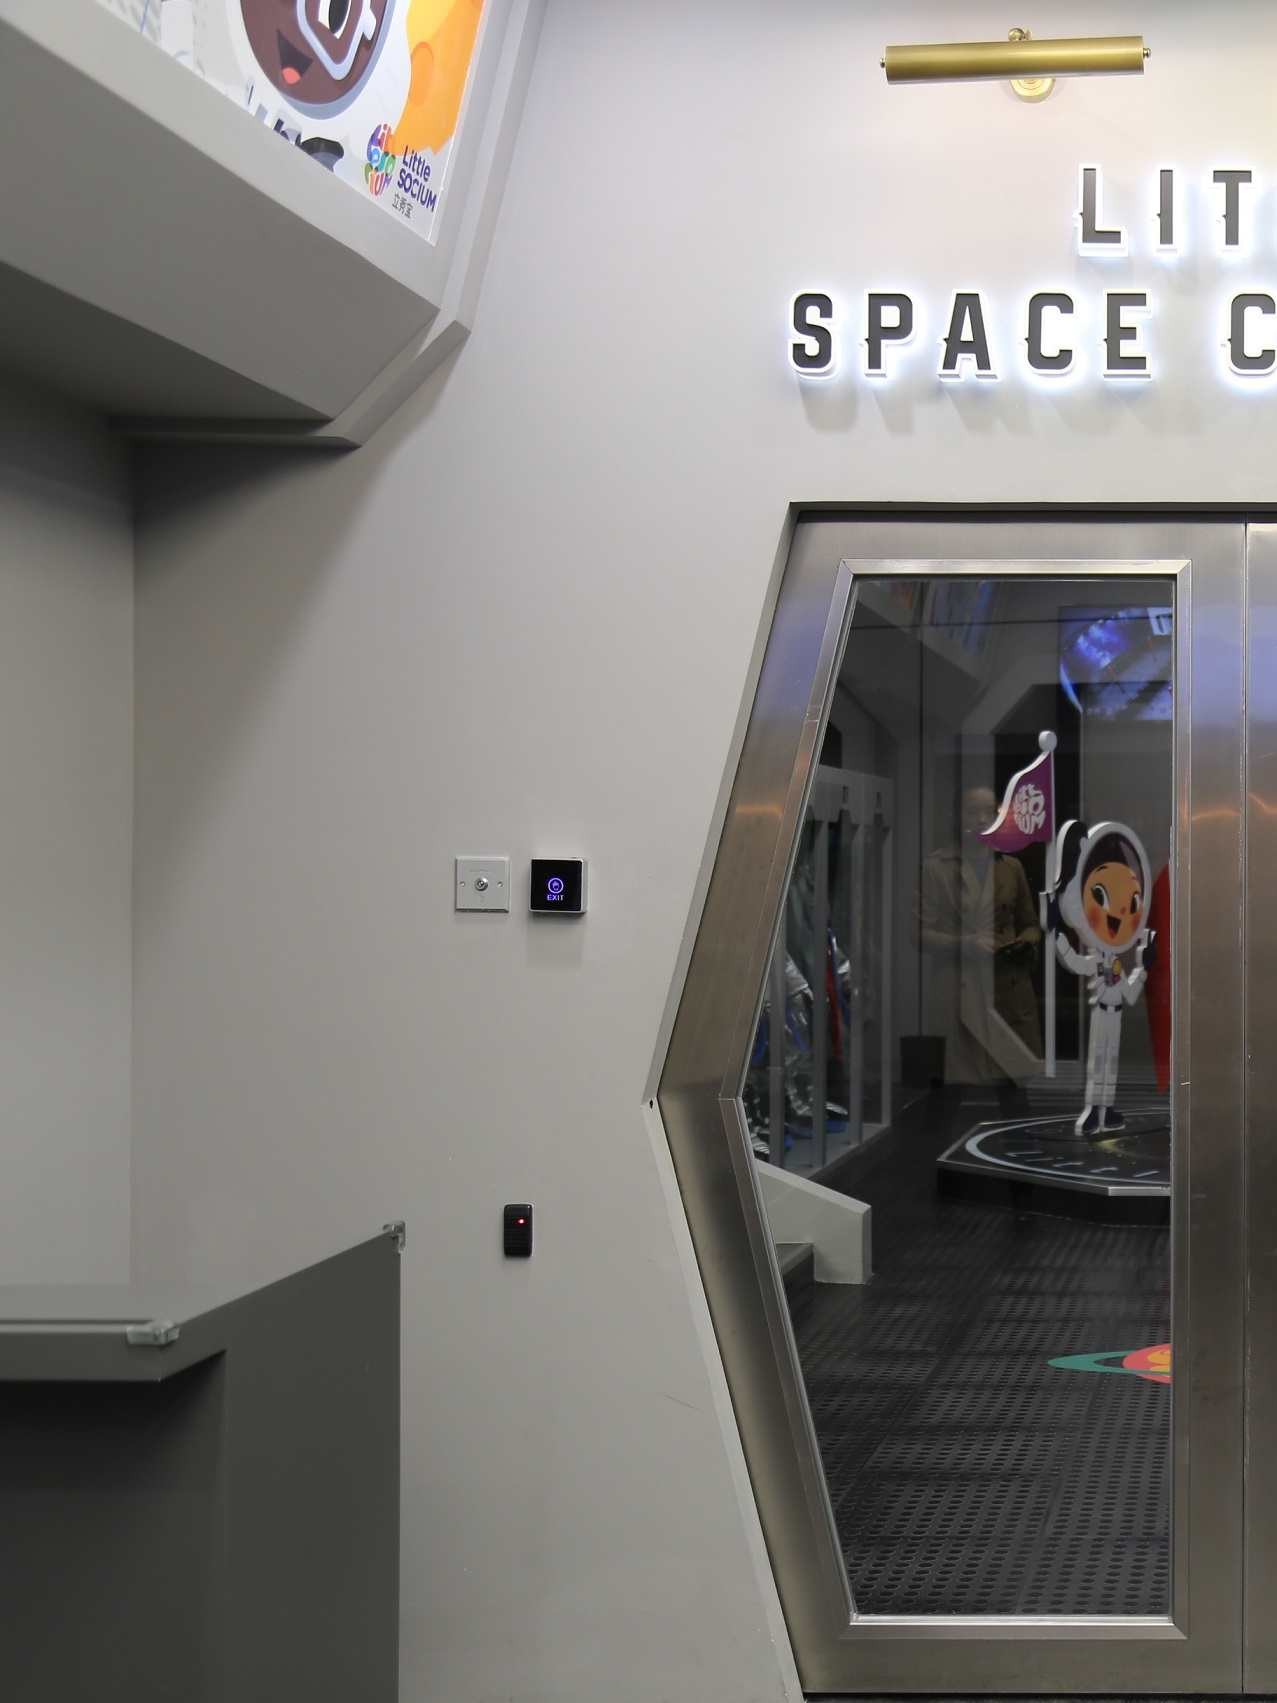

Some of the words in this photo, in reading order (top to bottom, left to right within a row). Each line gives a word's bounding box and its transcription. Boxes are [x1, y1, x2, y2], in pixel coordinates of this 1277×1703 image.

[402, 145, 431, 182] Little
[397, 167, 437, 212] SOCIUM
[789, 291, 1152, 378] SPACE
[546, 894, 565, 902] EXIT
